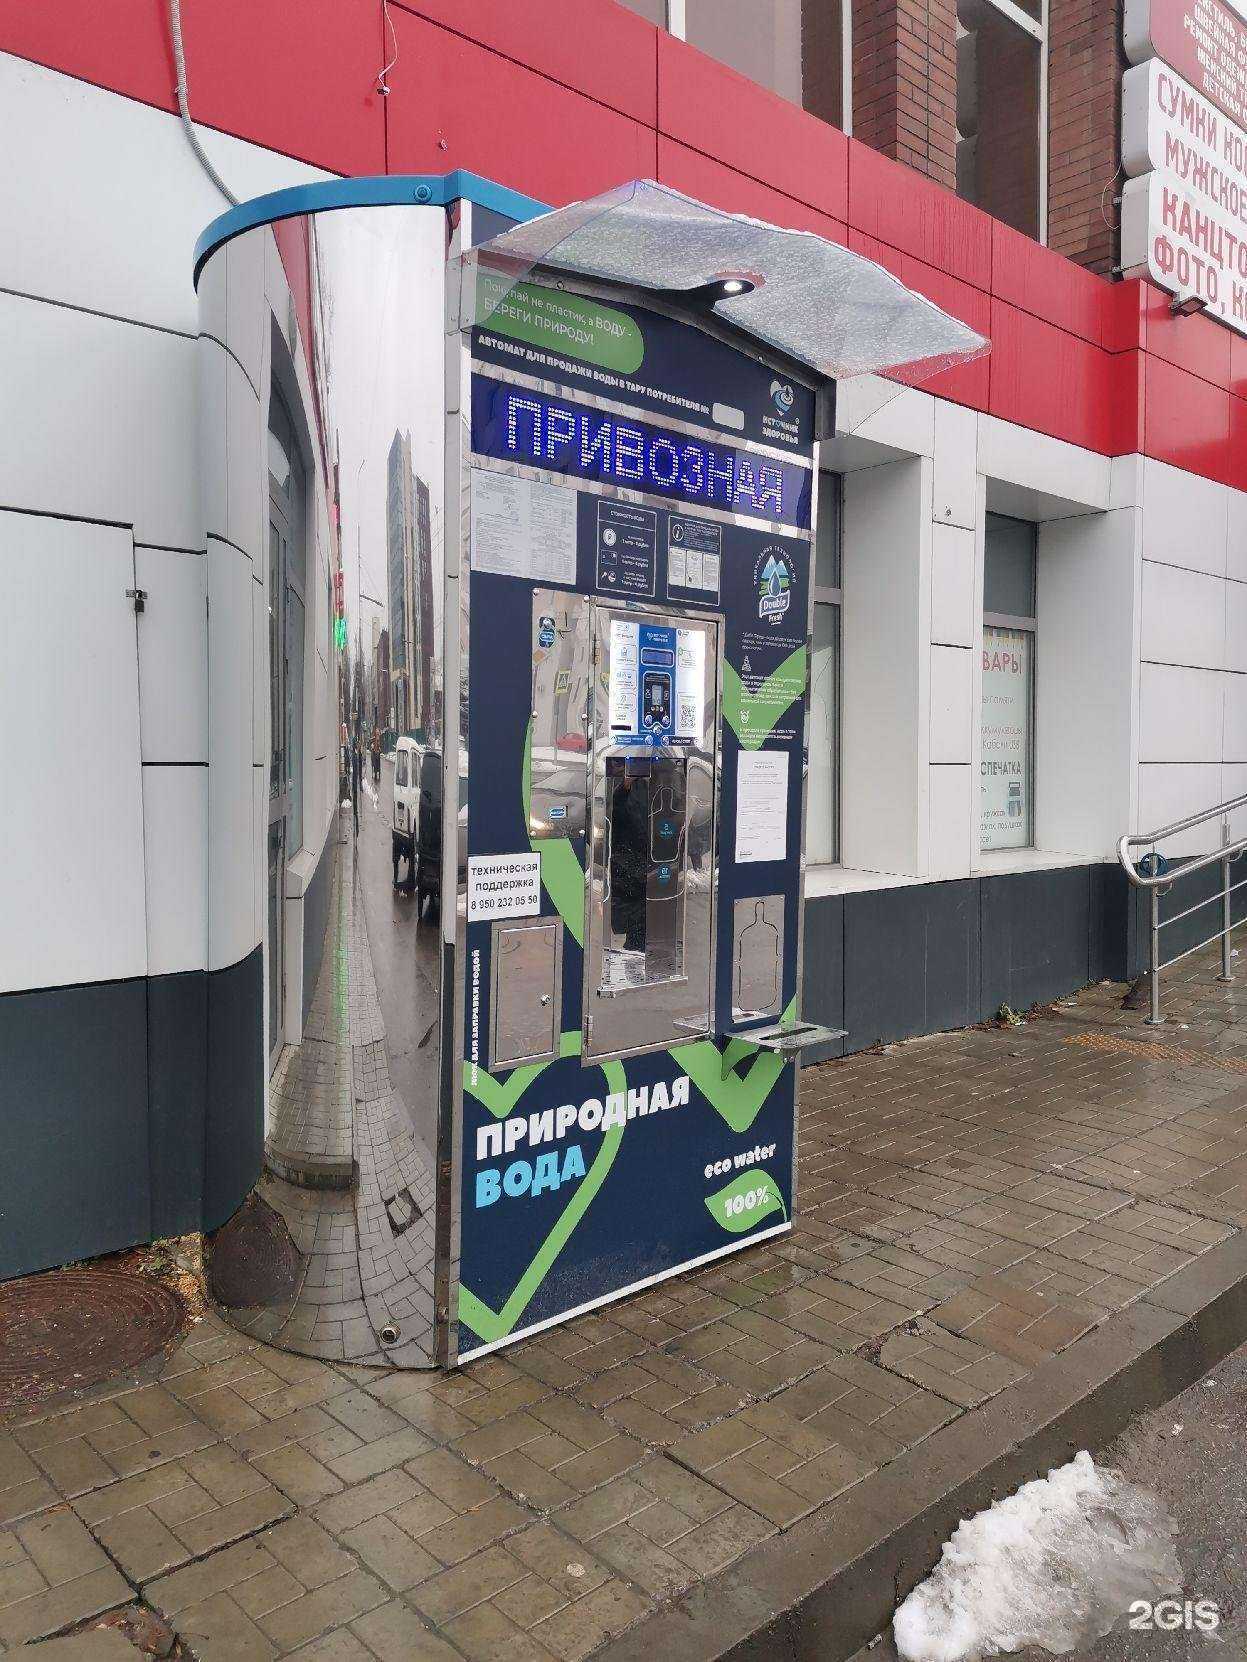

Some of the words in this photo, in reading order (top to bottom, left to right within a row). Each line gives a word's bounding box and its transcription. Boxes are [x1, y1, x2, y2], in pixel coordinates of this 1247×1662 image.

[1184, 12, 1218, 60] РЕМОНТ
[1157, 72, 1217, 152] СУМКИ
[1223, 125, 1247, 178] КО
[1164, 129, 1247, 224] МУЖСКОЕ
[531, 297, 544, 308] не
[1232, 280, 1247, 324] К
[484, 298, 531, 323] БЕРЕГИ
[534, 315, 594, 346] ПРИРОДУ!
[477, 334, 526, 357] АВТОМАТ
[525, 349, 546, 365] ДЛЯ
[546, 355, 592, 378] ПРОДАЖИ
[593, 370, 619, 386] ВОДЫ
[618, 379, 626, 389] В
[625, 381, 646, 395] ТАРУ
[646, 387, 701, 413] ПОТРЕБИТЕЛЯ
[761, 426, 799, 445] ЗДОРОВЬЯ
[762, 415, 799, 434] ИСТОЧНИК
[507, 395, 784, 514] ПРИВОЗНАЯ
[763, 597, 786, 611] Double
[470, 863, 538, 876] техническая
[475, 878, 534, 892] поддержка
[471, 900, 477, 910] 8
[479, 898, 495, 909] 950
[497, 896, 513, 908] 232
[527, 894, 538, 904] 50
[471, 948, 481, 985] ВОДОЙ
[471, 986, 481, 1039] ЗАПРАВКИ
[471, 1040, 481, 1061] ДЛЯ
[476, 1076, 690, 1161] ПРИРОДНАЯ
[475, 1144, 587, 1209] ВОДА
[704, 1158, 732, 1179] eco
[733, 1143, 777, 1169] water
[725, 1185, 769, 1218] 100%
